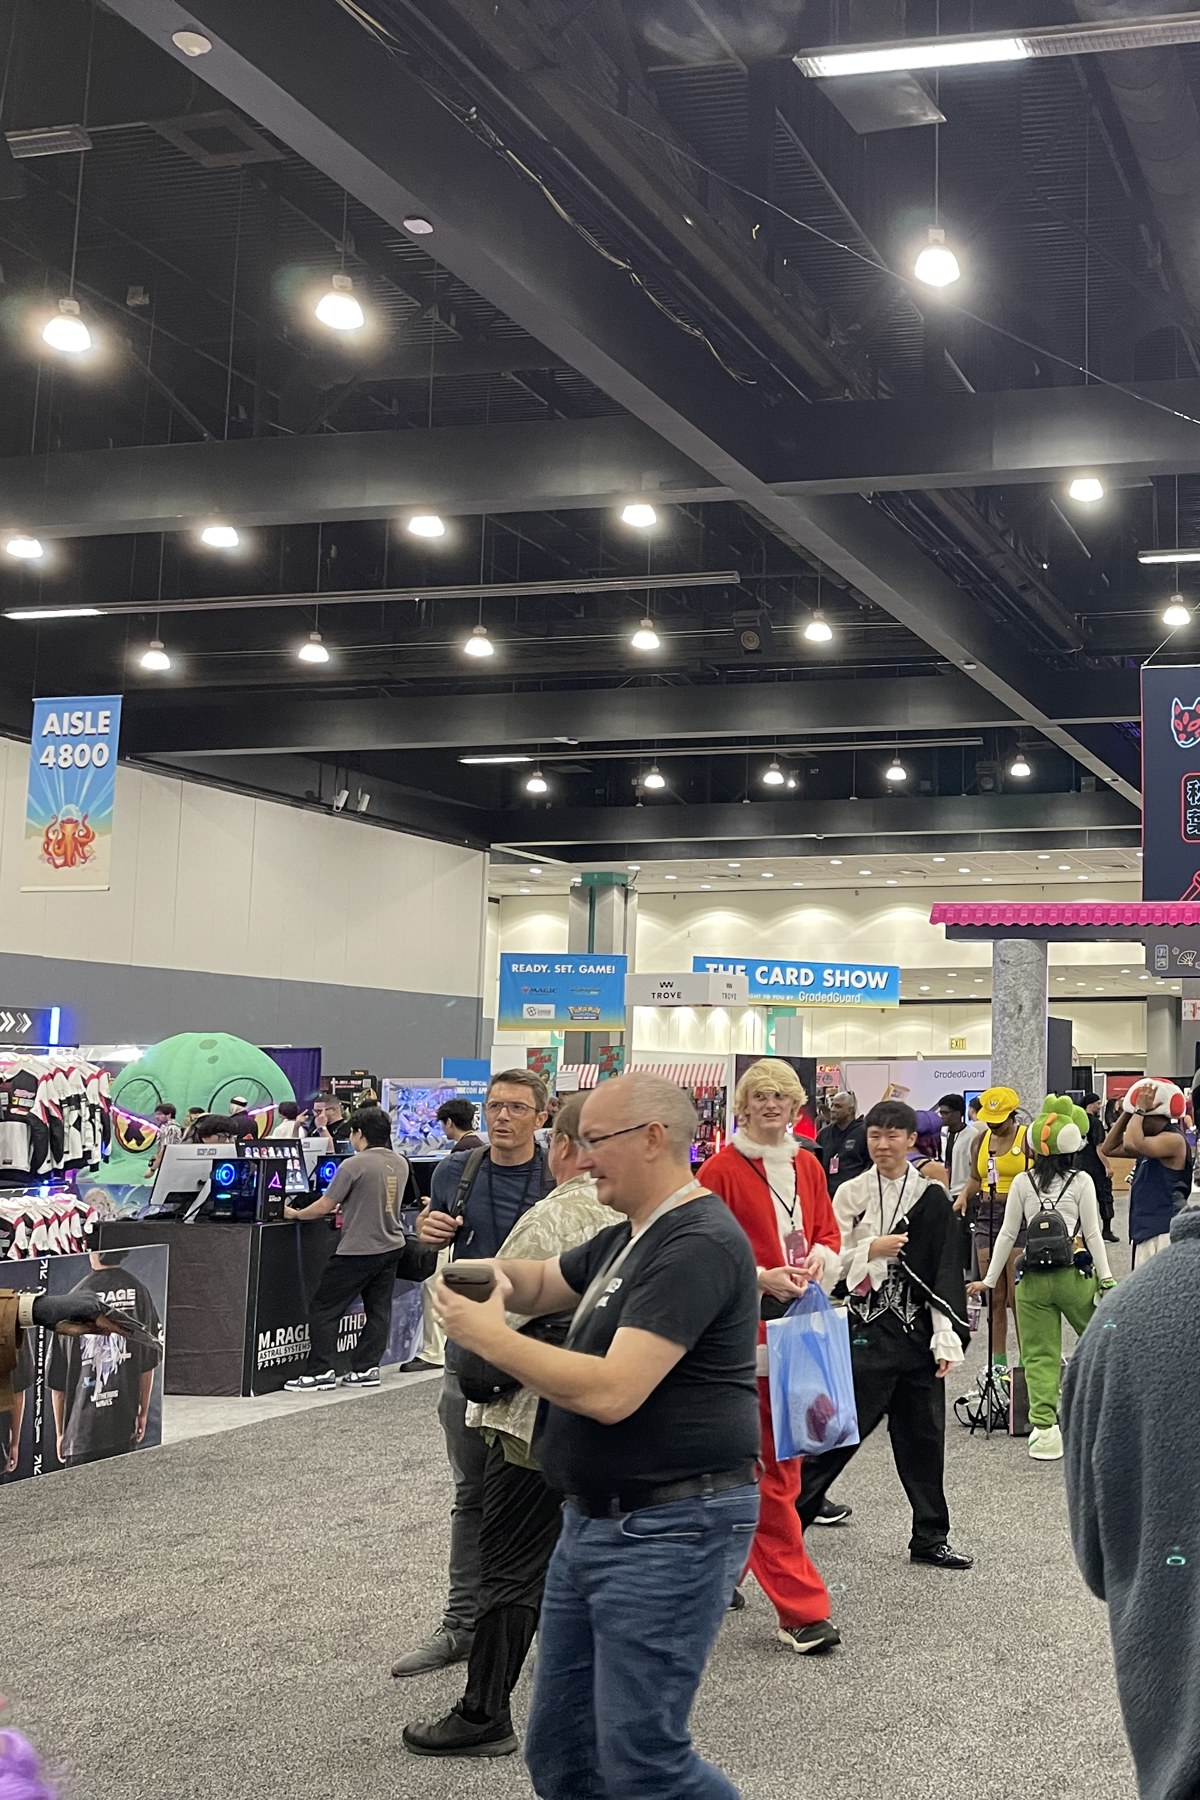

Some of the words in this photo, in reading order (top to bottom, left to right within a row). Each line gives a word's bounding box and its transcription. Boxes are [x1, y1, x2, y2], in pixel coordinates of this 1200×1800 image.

[42, 711, 110, 736] AISLE
[40, 743, 109, 768] 4800
[511, 964, 551, 973] READY.
[554, 964, 576, 973] SET.
[578, 964, 615, 974] GAME!
[755, 966, 815, 986] CARD
[822, 970, 889, 989] SHOW
[799, 991, 861, 1003] GradedGuard
[951, 1038, 965, 1049] EXIT
[934, 1070, 985, 1079] GradedGuard
[260, 1347, 283, 1361] ASTRAL
